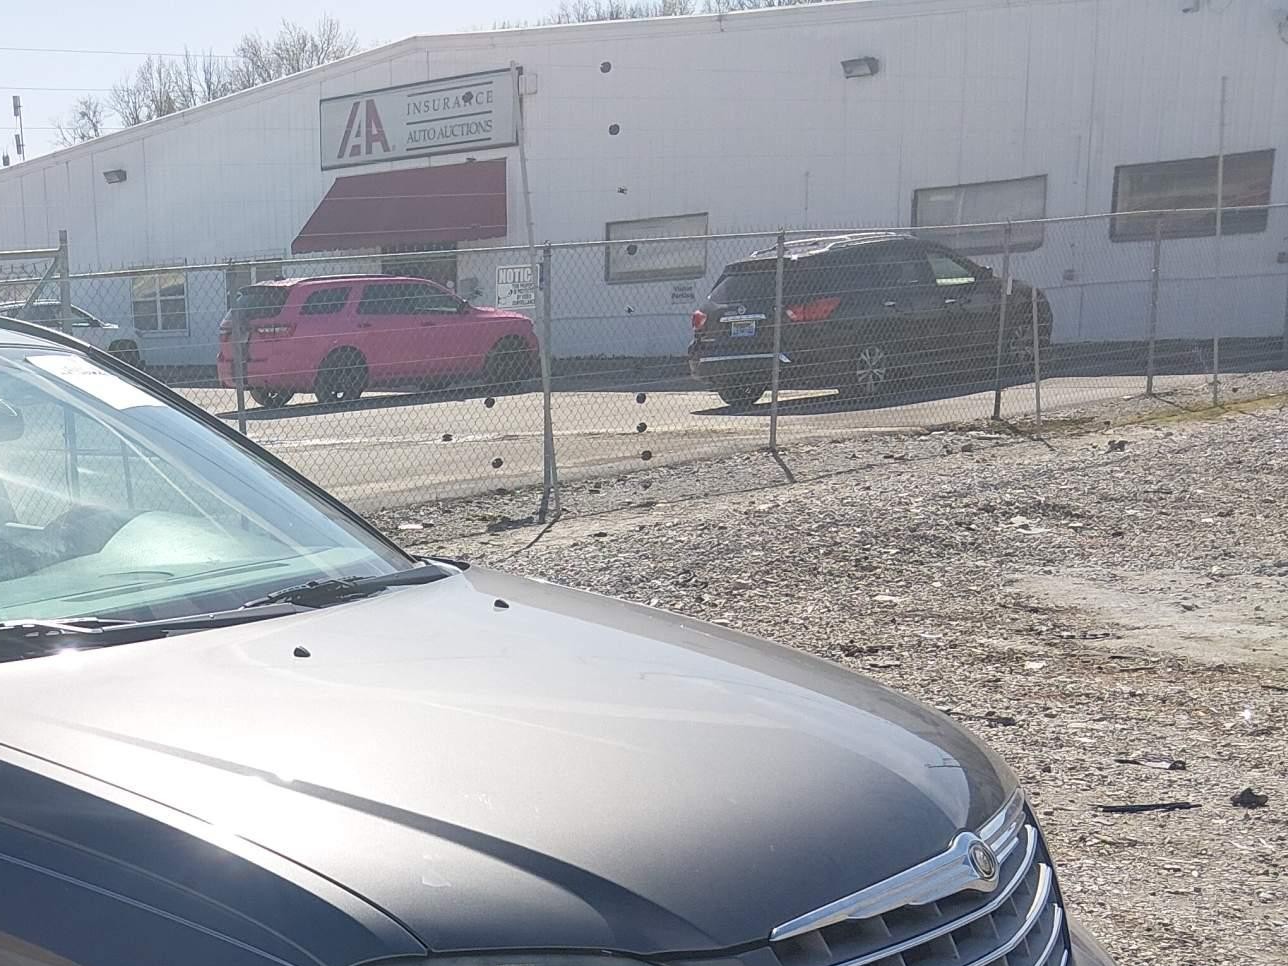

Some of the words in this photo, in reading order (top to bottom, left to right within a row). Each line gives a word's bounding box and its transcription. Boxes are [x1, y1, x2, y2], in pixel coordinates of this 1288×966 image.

[407, 127, 436, 144] AUTO
[438, 120, 493, 140] AUCTIONS
[498, 267, 533, 284] NOTIC
